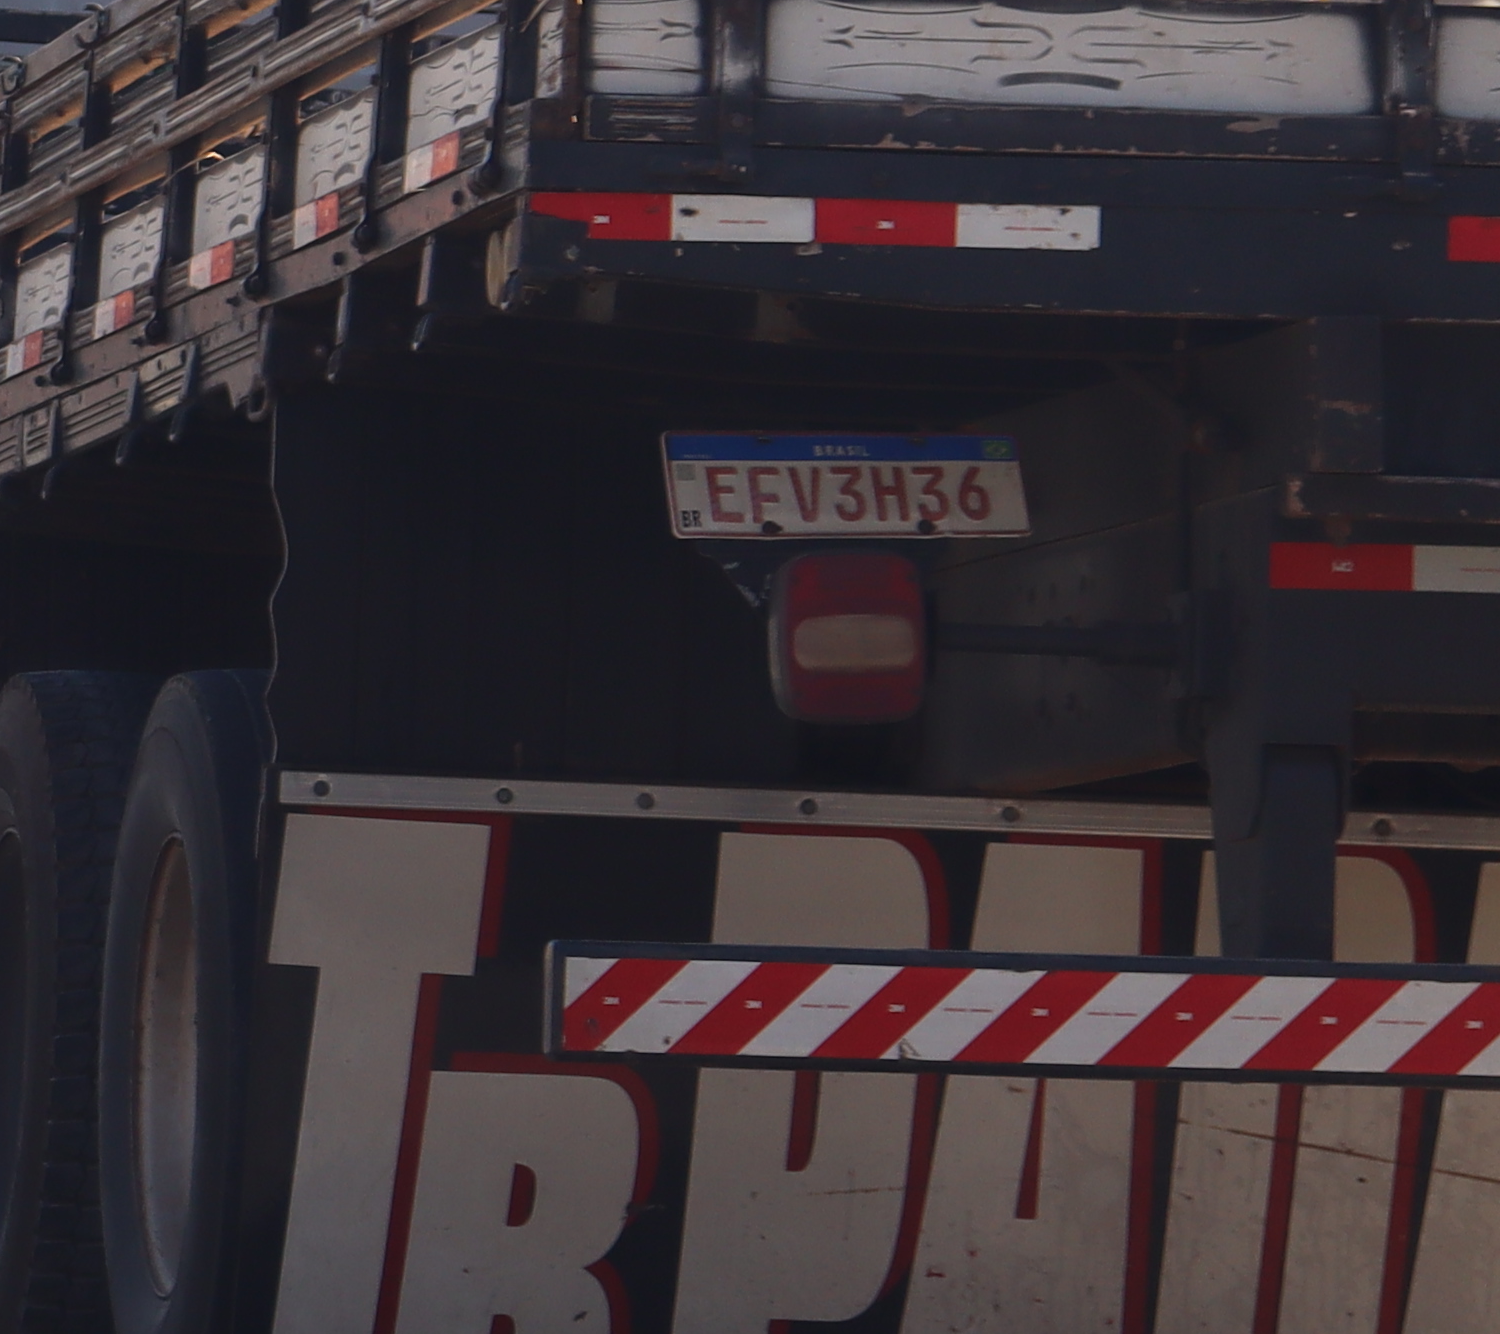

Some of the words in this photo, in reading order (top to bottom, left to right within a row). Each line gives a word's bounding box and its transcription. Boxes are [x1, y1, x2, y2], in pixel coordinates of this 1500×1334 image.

[812, 444, 871, 458] BRASIL
[705, 466, 993, 525] EFV3H36
[681, 510, 702, 528] BR
